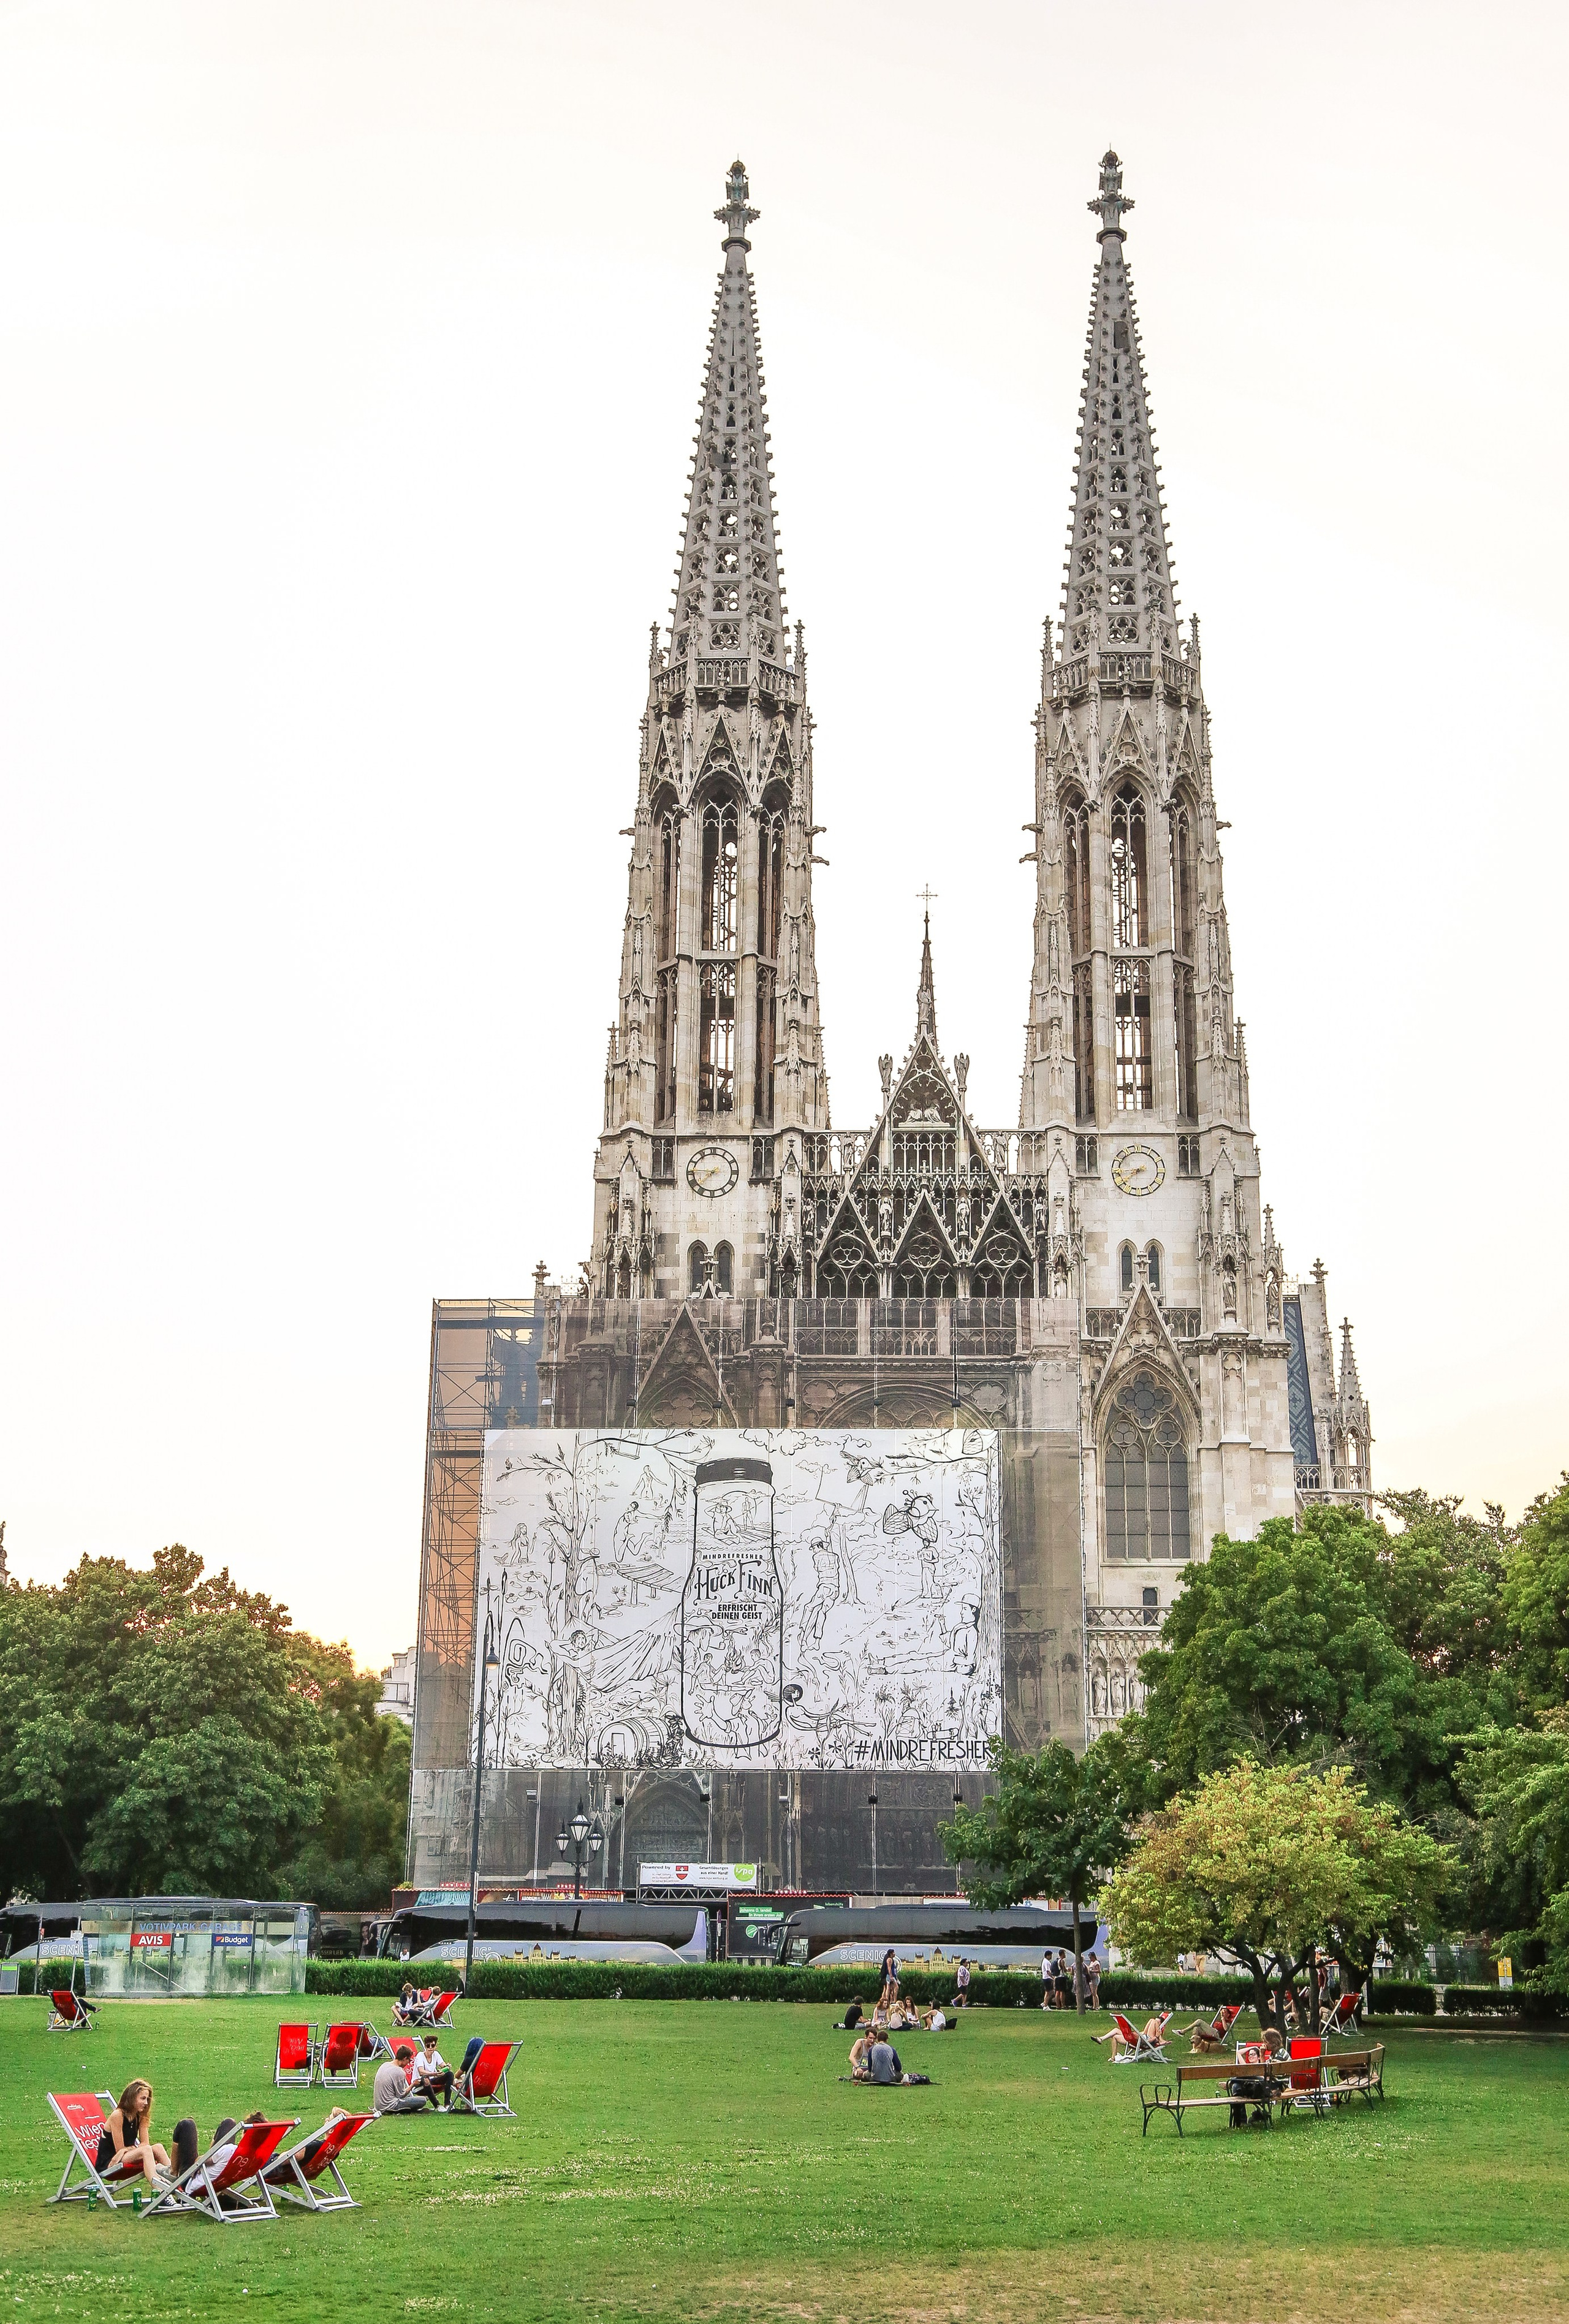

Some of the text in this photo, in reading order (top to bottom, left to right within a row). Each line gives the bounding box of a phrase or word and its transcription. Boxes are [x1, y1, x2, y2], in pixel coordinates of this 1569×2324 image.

[854, 1739, 993, 1761] #MINDREFRESHER
[138, 1935, 164, 1945] AVIS
[224, 1936, 248, 1945] Budget
[441, 1946, 488, 1958] SCEIC
